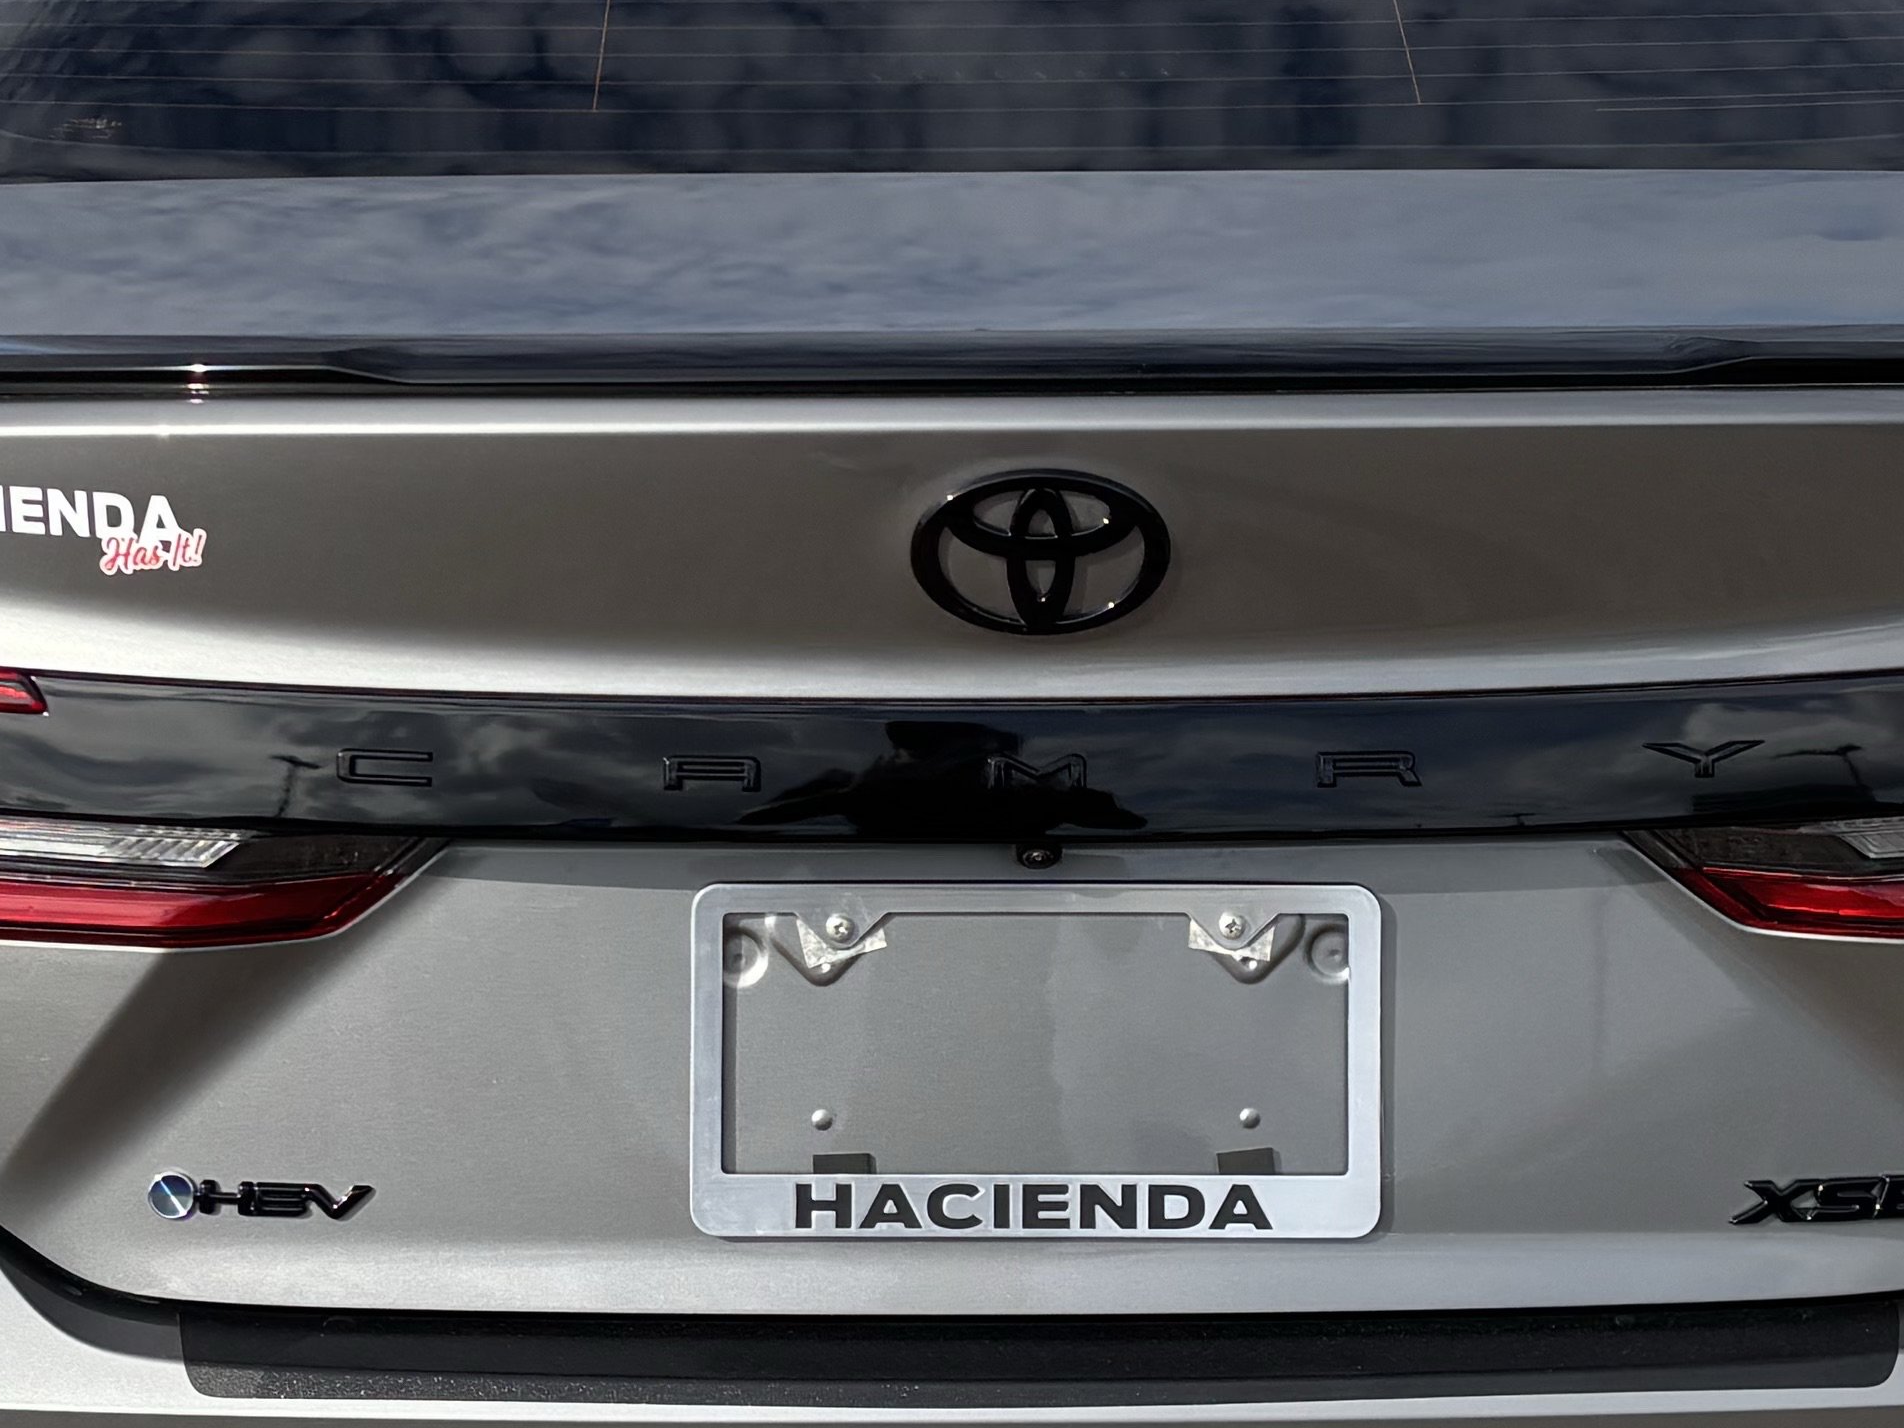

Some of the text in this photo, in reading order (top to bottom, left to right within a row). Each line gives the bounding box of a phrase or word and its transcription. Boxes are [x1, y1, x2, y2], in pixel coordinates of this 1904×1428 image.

[104, 532, 203, 571] Has It!
[334, 737, 1766, 794] CAMRY
[197, 1179, 377, 1221] HEV
[794, 1183, 1273, 1230] HACIENDA
